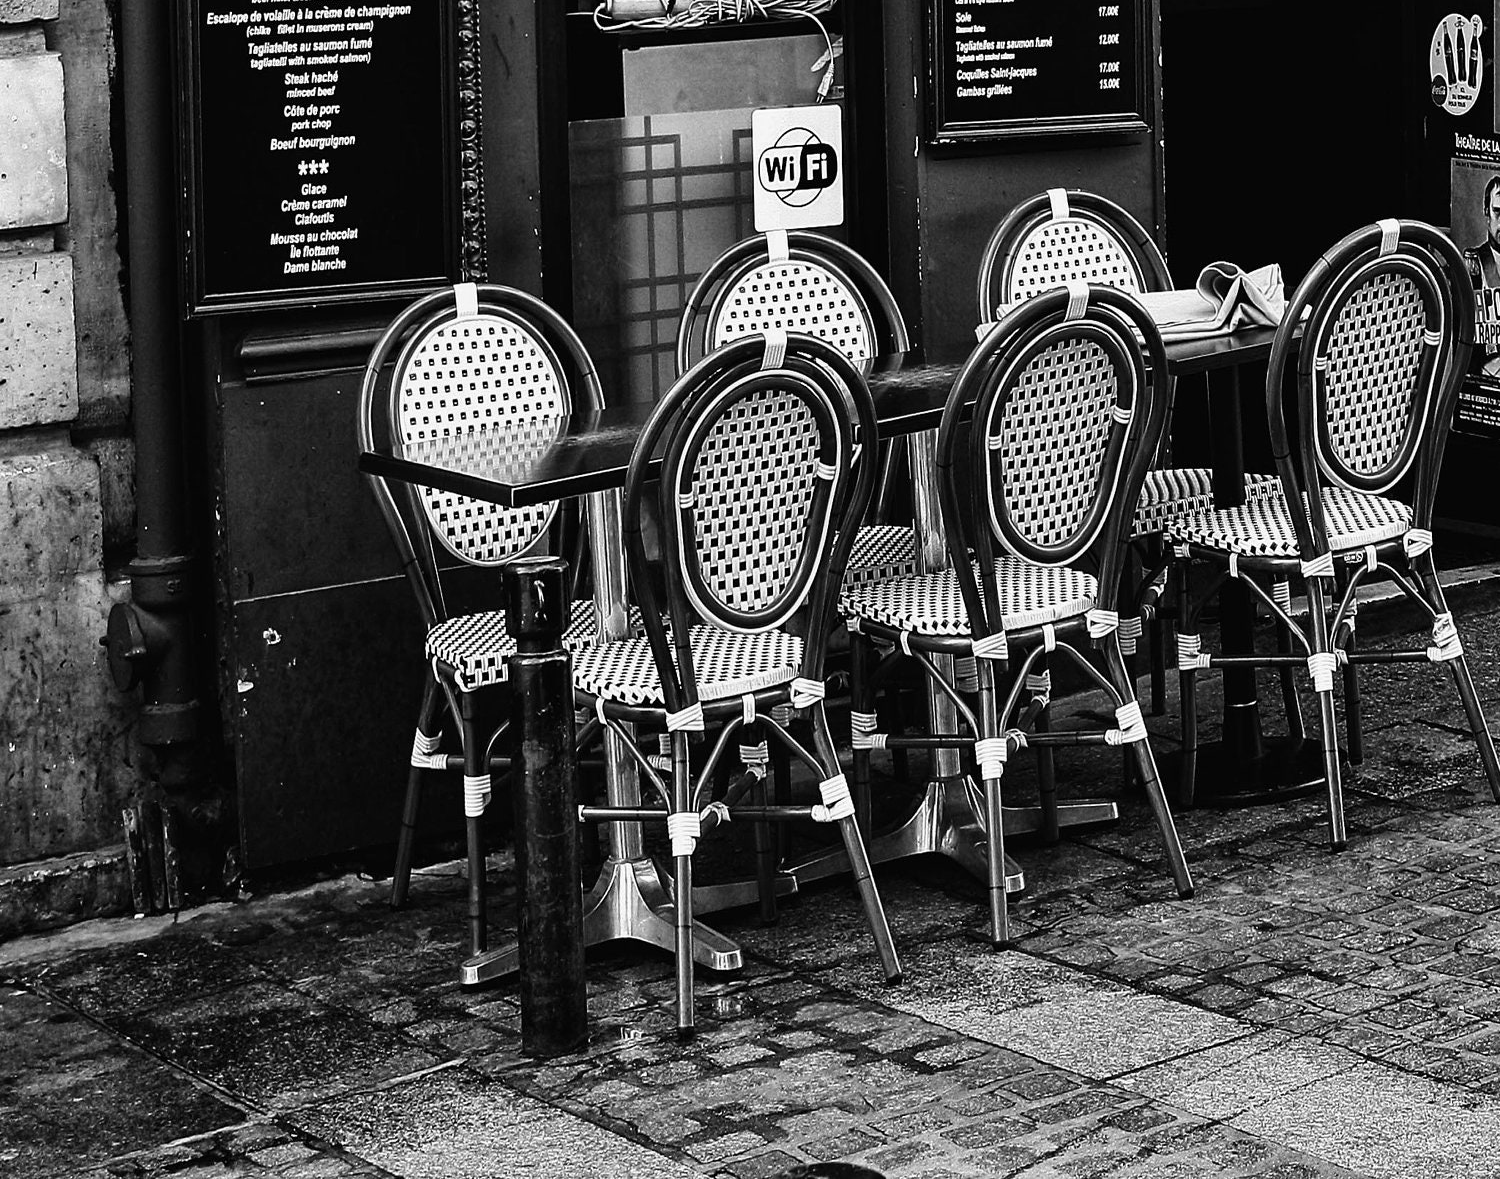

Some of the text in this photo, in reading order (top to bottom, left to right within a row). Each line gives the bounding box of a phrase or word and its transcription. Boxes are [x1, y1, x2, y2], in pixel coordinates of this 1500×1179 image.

[247, 36, 372, 57] Tagliatelles au saumon fumé
[284, 70, 338, 84] Steak haché
[283, 103, 340, 117] Côte de porc
[270, 135, 355, 150] Boeuf bourguignon
[1482, 139, 1491, 152] DE
[1491, 140, 1500, 154] LA
[301, 183, 327, 196] Glace
[281, 196, 347, 212] Crème caramel
[294, 212, 334, 225] Clafoutis
[270, 228, 358, 245] Mousse au chocolat
[283, 258, 346, 274] Dame blanche
